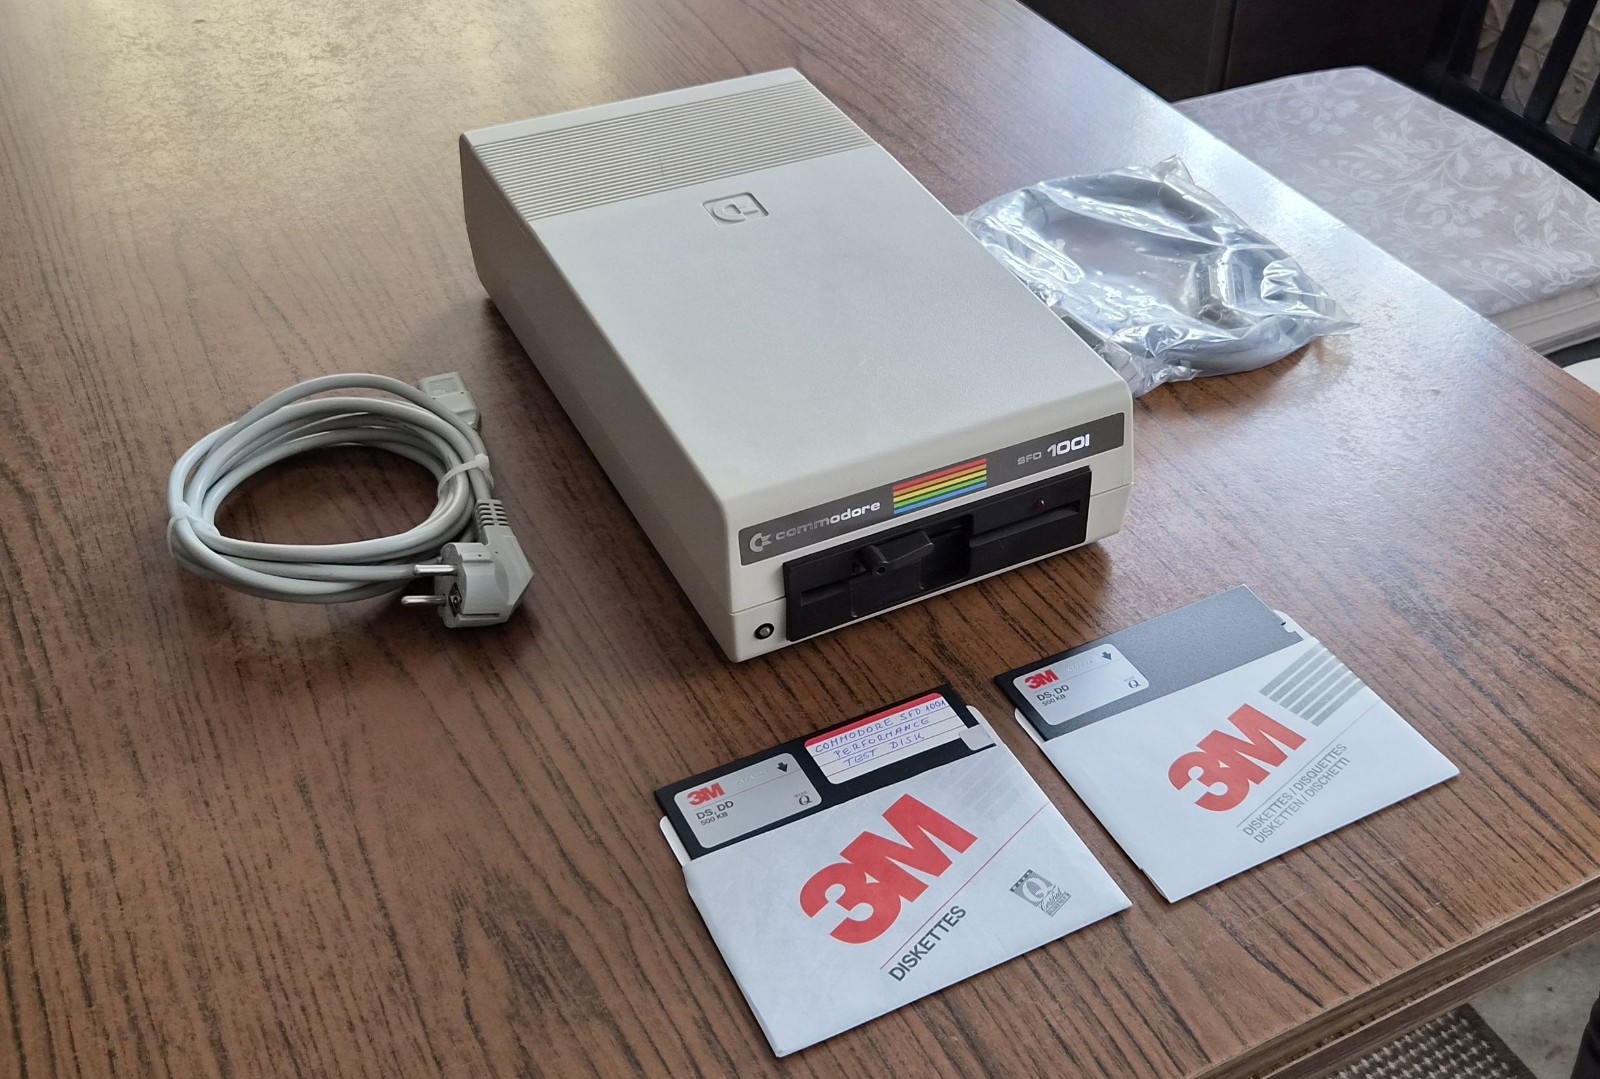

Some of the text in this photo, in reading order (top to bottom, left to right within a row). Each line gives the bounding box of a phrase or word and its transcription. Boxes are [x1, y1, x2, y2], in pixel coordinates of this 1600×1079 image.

[1017, 451, 1042, 465] SFD
[775, 501, 881, 541] commodore
[1024, 669, 1059, 689] 3M
[1036, 684, 1070, 701] DS, DD
[1128, 678, 1141, 689] Q
[1042, 694, 1066, 707] 500 KB
[815, 699, 946, 753] COMMODORE SFD 1001
[833, 718, 930, 758] PERFORMANCE
[843, 732, 925, 767] TEST DISK
[1168, 703, 1307, 813] 3M
[686, 782, 726, 806] 3M
[798, 793, 812, 806] Q
[1242, 792, 1293, 836] DISKETTES
[1293, 743, 1348, 792] DISQUETTES
[1253, 798, 1306, 844] DISKETTEN
[1304, 757, 1351, 797] DISCHETTI
[696, 800, 734, 820] DS, DD
[700, 811, 729, 826] 500 KB
[800, 793, 978, 944] 3M
[888, 905, 967, 982] DISKETTES
